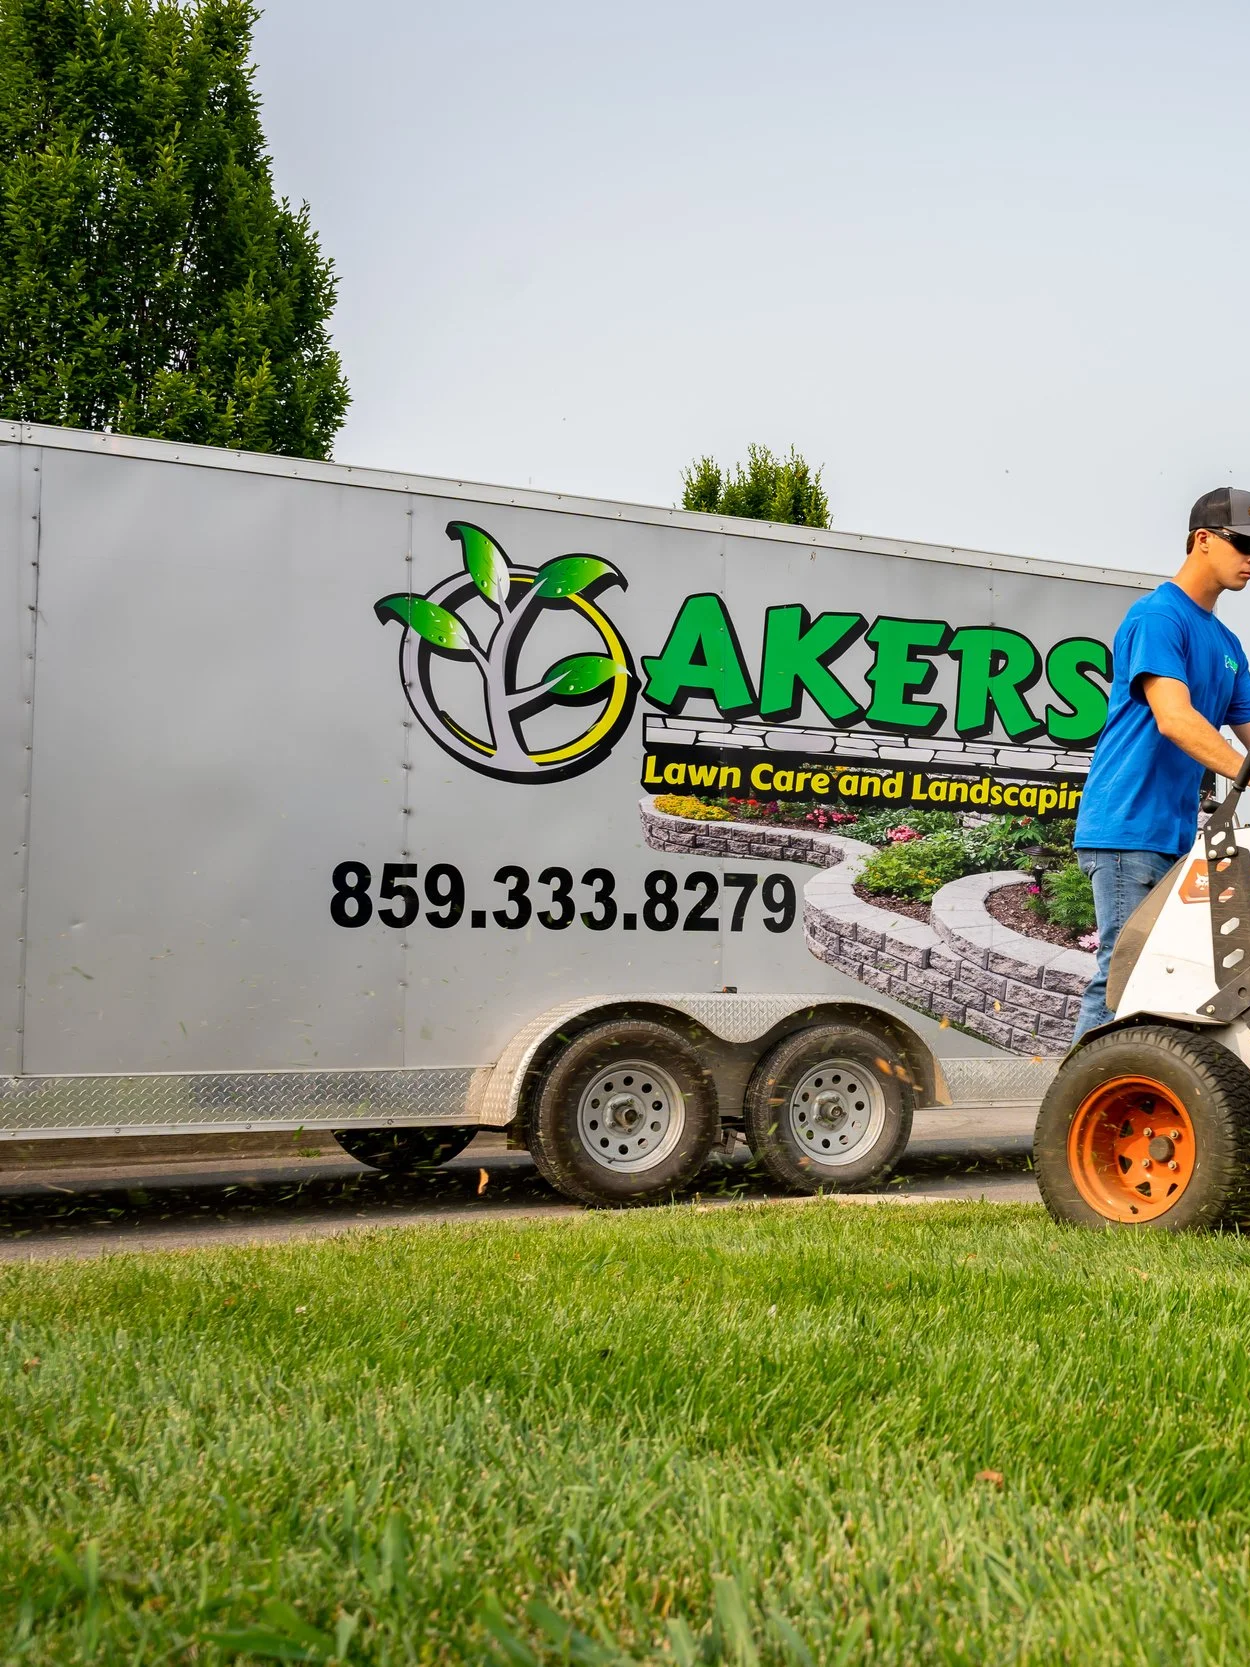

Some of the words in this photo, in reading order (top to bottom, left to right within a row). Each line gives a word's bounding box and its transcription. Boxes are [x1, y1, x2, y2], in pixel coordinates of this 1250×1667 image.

[641, 593, 1112, 746] AKERS
[644, 755, 742, 789] Lawn
[750, 762, 831, 795] Care
[838, 771, 905, 799] and
[911, 773, 1083, 815] Landscapin
[330, 860, 797, 934] 859.333.8279
